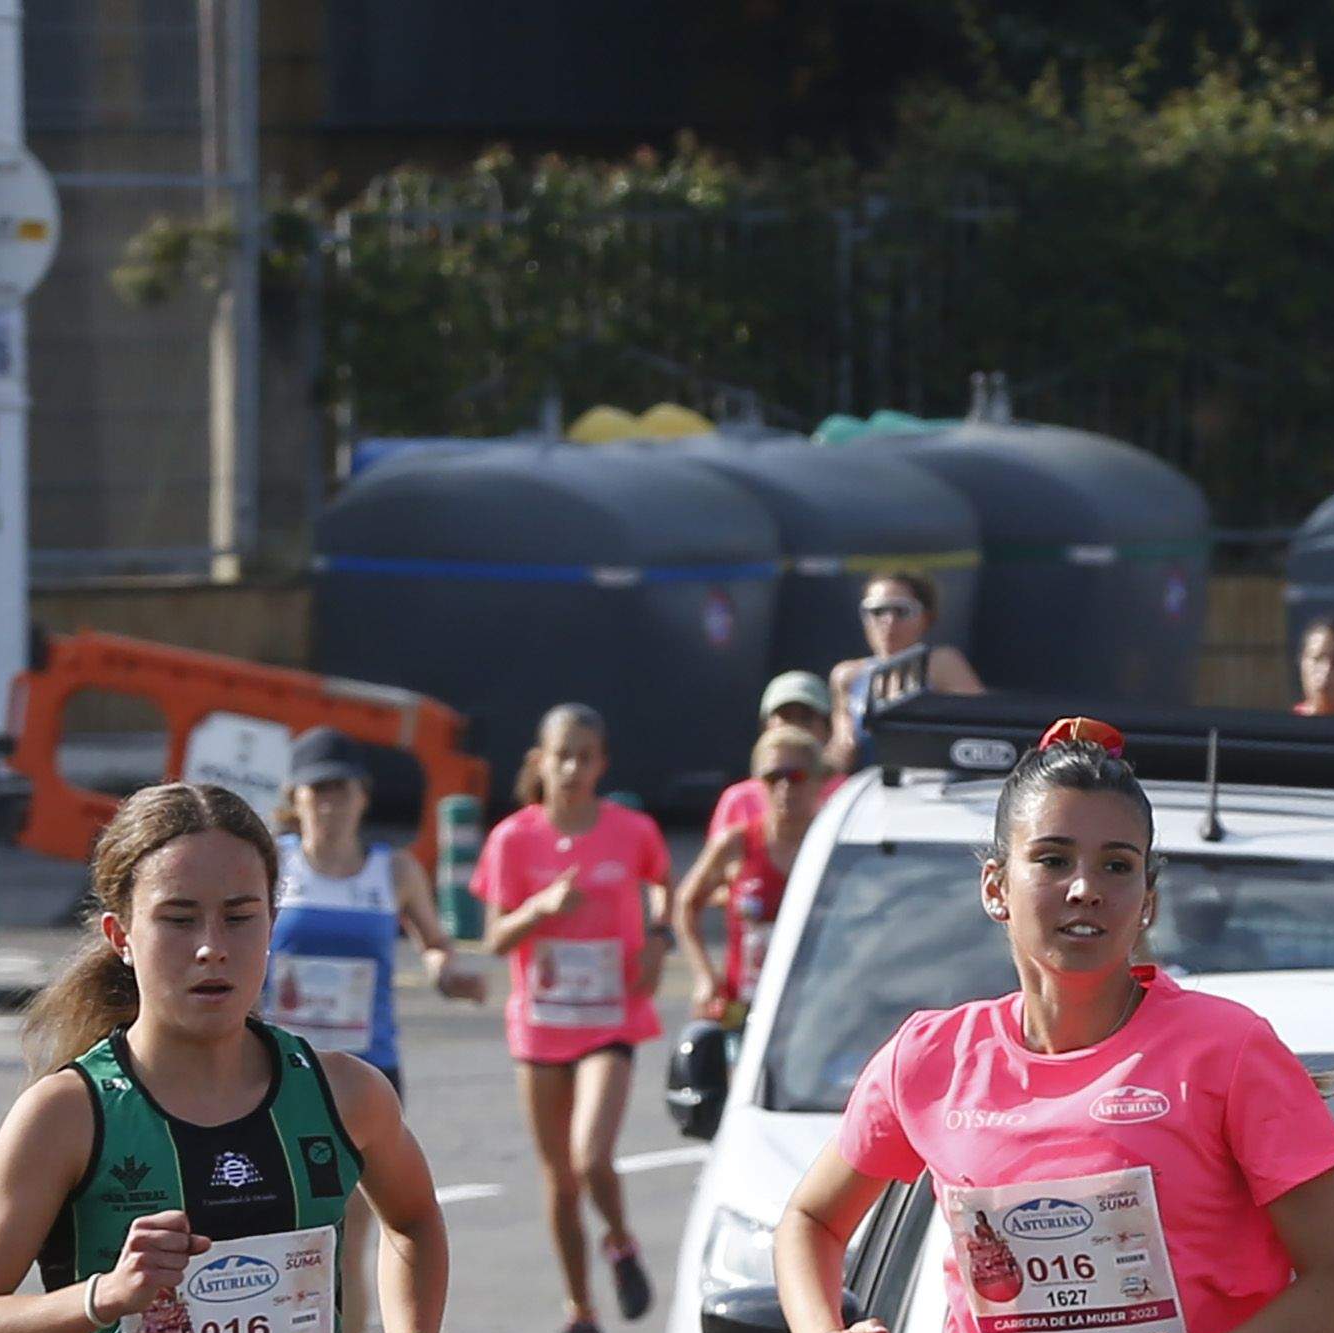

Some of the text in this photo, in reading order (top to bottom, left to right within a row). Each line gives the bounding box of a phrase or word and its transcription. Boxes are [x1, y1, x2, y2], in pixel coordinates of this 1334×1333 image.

[1095, 1101, 1164, 1118] ASTURIANA
[945, 1109, 1027, 1130] OYSHO
[1099, 1196, 1140, 1212] SUMA
[1011, 1215, 1088, 1233] ASTURIANA
[285, 1255, 323, 1270] SUMA
[1026, 1253, 1095, 1282] 016
[195, 1273, 273, 1295] ASTURIANA
[1047, 1289, 1088, 1307] 1627
[994, 1306, 1159, 1331] CARRERA DE LA MUJER 2023
